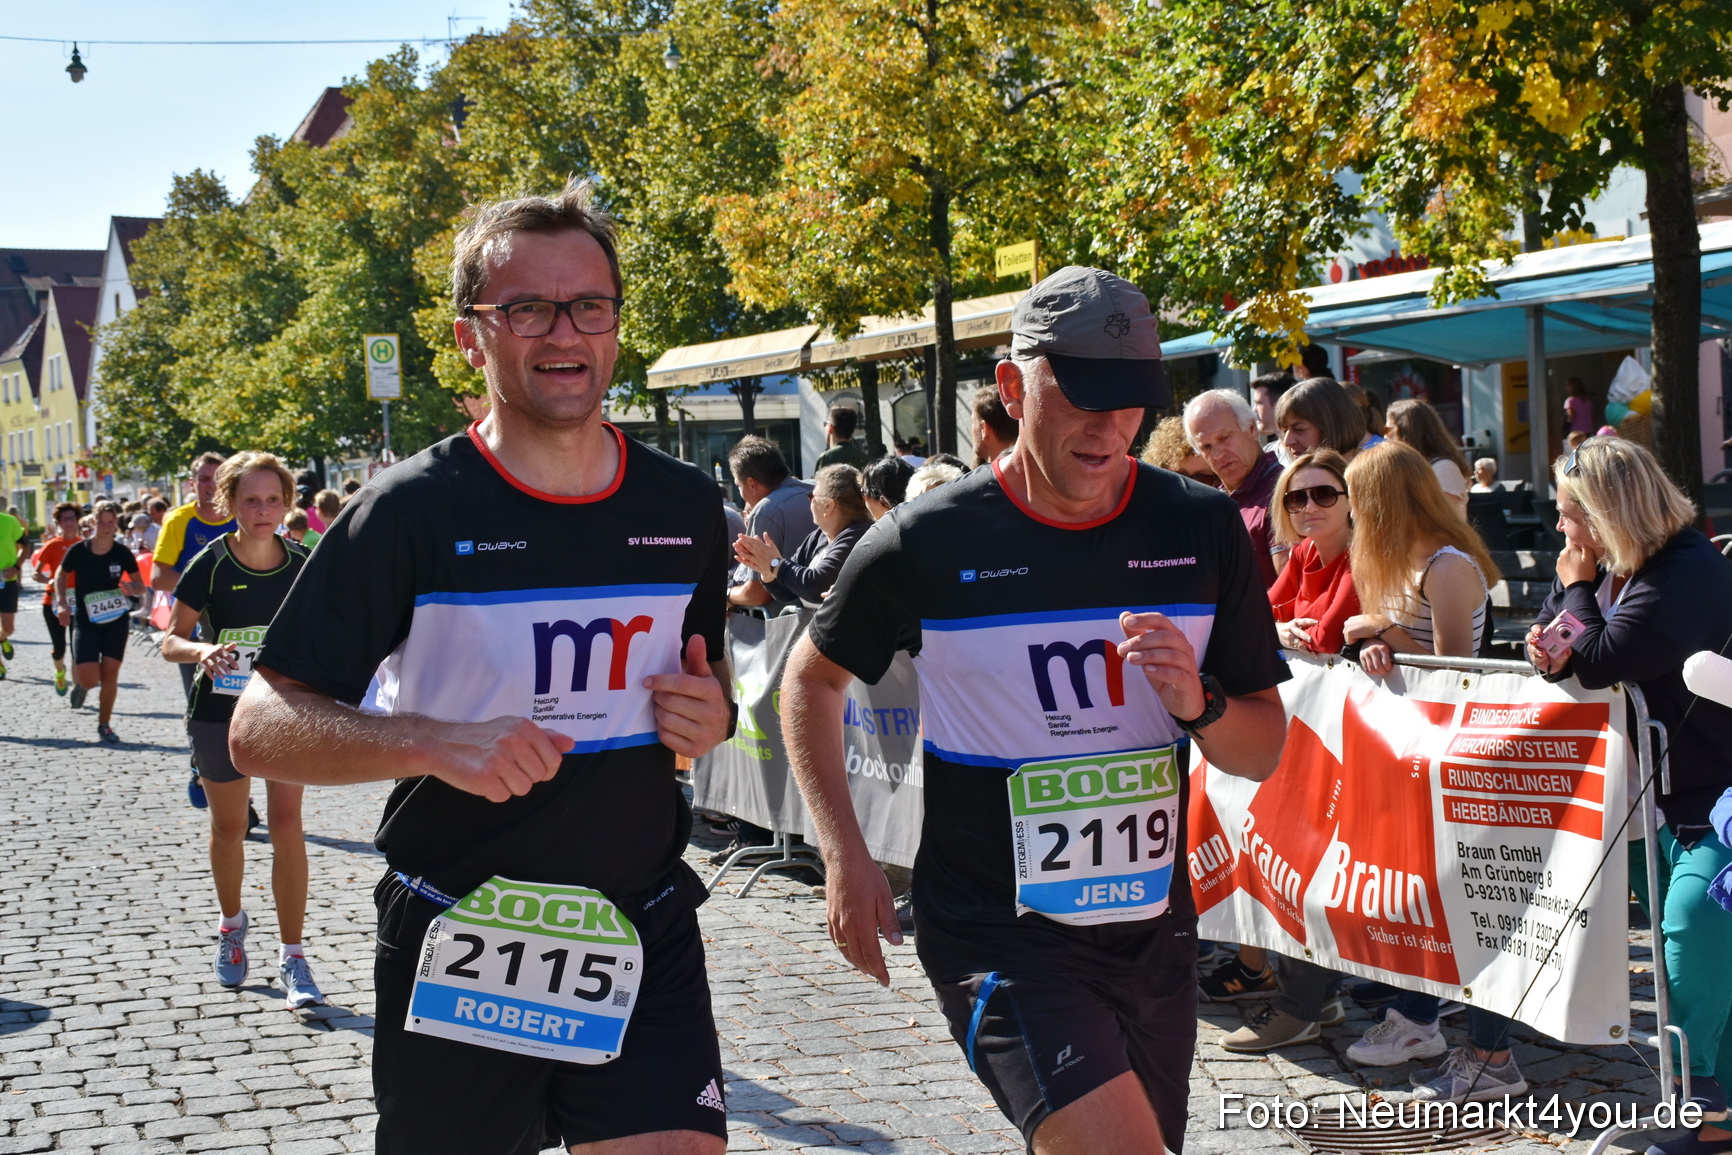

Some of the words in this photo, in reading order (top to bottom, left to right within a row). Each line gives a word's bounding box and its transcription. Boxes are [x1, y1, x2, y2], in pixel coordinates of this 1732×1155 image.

[1003, 252, 1032, 267] Toiletten
[628, 537, 640, 545] SV
[642, 536, 692, 545] ILLSCHWANG
[1128, 560, 1139, 568] SV
[1140, 556, 1196, 568] ILLSCHWANG
[91, 598, 122, 615] 2449
[534, 697, 559, 705] Heizung
[532, 713, 575, 722] Regenerative
[577, 712, 607, 721] Energien
[1045, 714, 1072, 722] Heizung
[1469, 707, 1542, 725] BINDESTRICKE
[1453, 737, 1579, 759] VERZURRSYSTEME
[1027, 758, 1171, 803] BOCK
[1332, 778, 1343, 802] 1929
[1448, 768, 1572, 793] RUNDSCHLINGEN
[1451, 802, 1553, 825] HEBEBÄNDER
[1038, 808, 1170, 872] 2119
[1457, 841, 1496, 860] Braun
[1500, 845, 1542, 863] GmbH
[1188, 833, 1230, 881] aun
[1238, 808, 1302, 909] Braun
[1199, 876, 1219, 893] Sicher
[1324, 841, 1435, 928] Braun
[1461, 863, 1481, 880] Am
[1485, 864, 1544, 890] Grünberg
[1547, 870, 1552, 888] 8
[1074, 880, 1146, 907] JENS
[1464, 883, 1516, 902] D-92318
[456, 884, 623, 935] BOCK
[1470, 912, 1495, 929] Tel.
[1498, 914, 1527, 937] 09181
[1367, 925, 1400, 945] Sicher
[1402, 932, 1418, 948] ist
[1420, 935, 1453, 954] sicher
[1476, 932, 1499, 950] Fax
[1501, 935, 1527, 958] 09181
[444, 933, 617, 1003] 2115
[624, 961, 634, 971] D
[454, 996, 585, 1041] ROBERT
